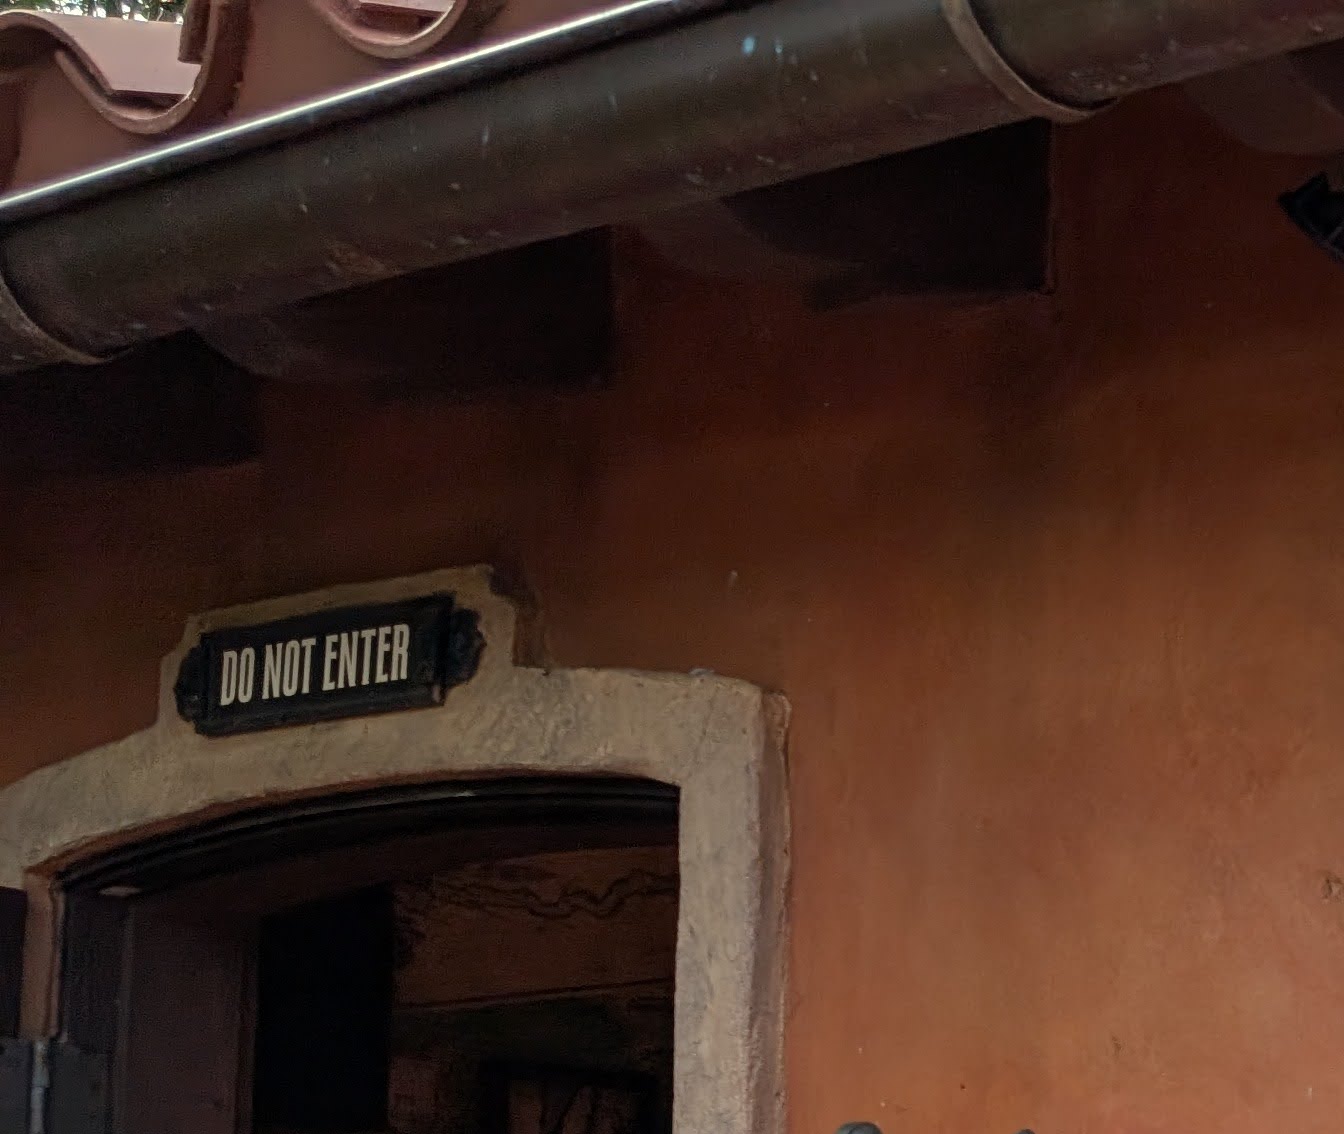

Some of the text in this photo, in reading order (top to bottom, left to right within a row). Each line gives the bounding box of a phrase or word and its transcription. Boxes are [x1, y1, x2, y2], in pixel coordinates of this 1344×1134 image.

[220, 623, 411, 706] DO NOT ENTER
